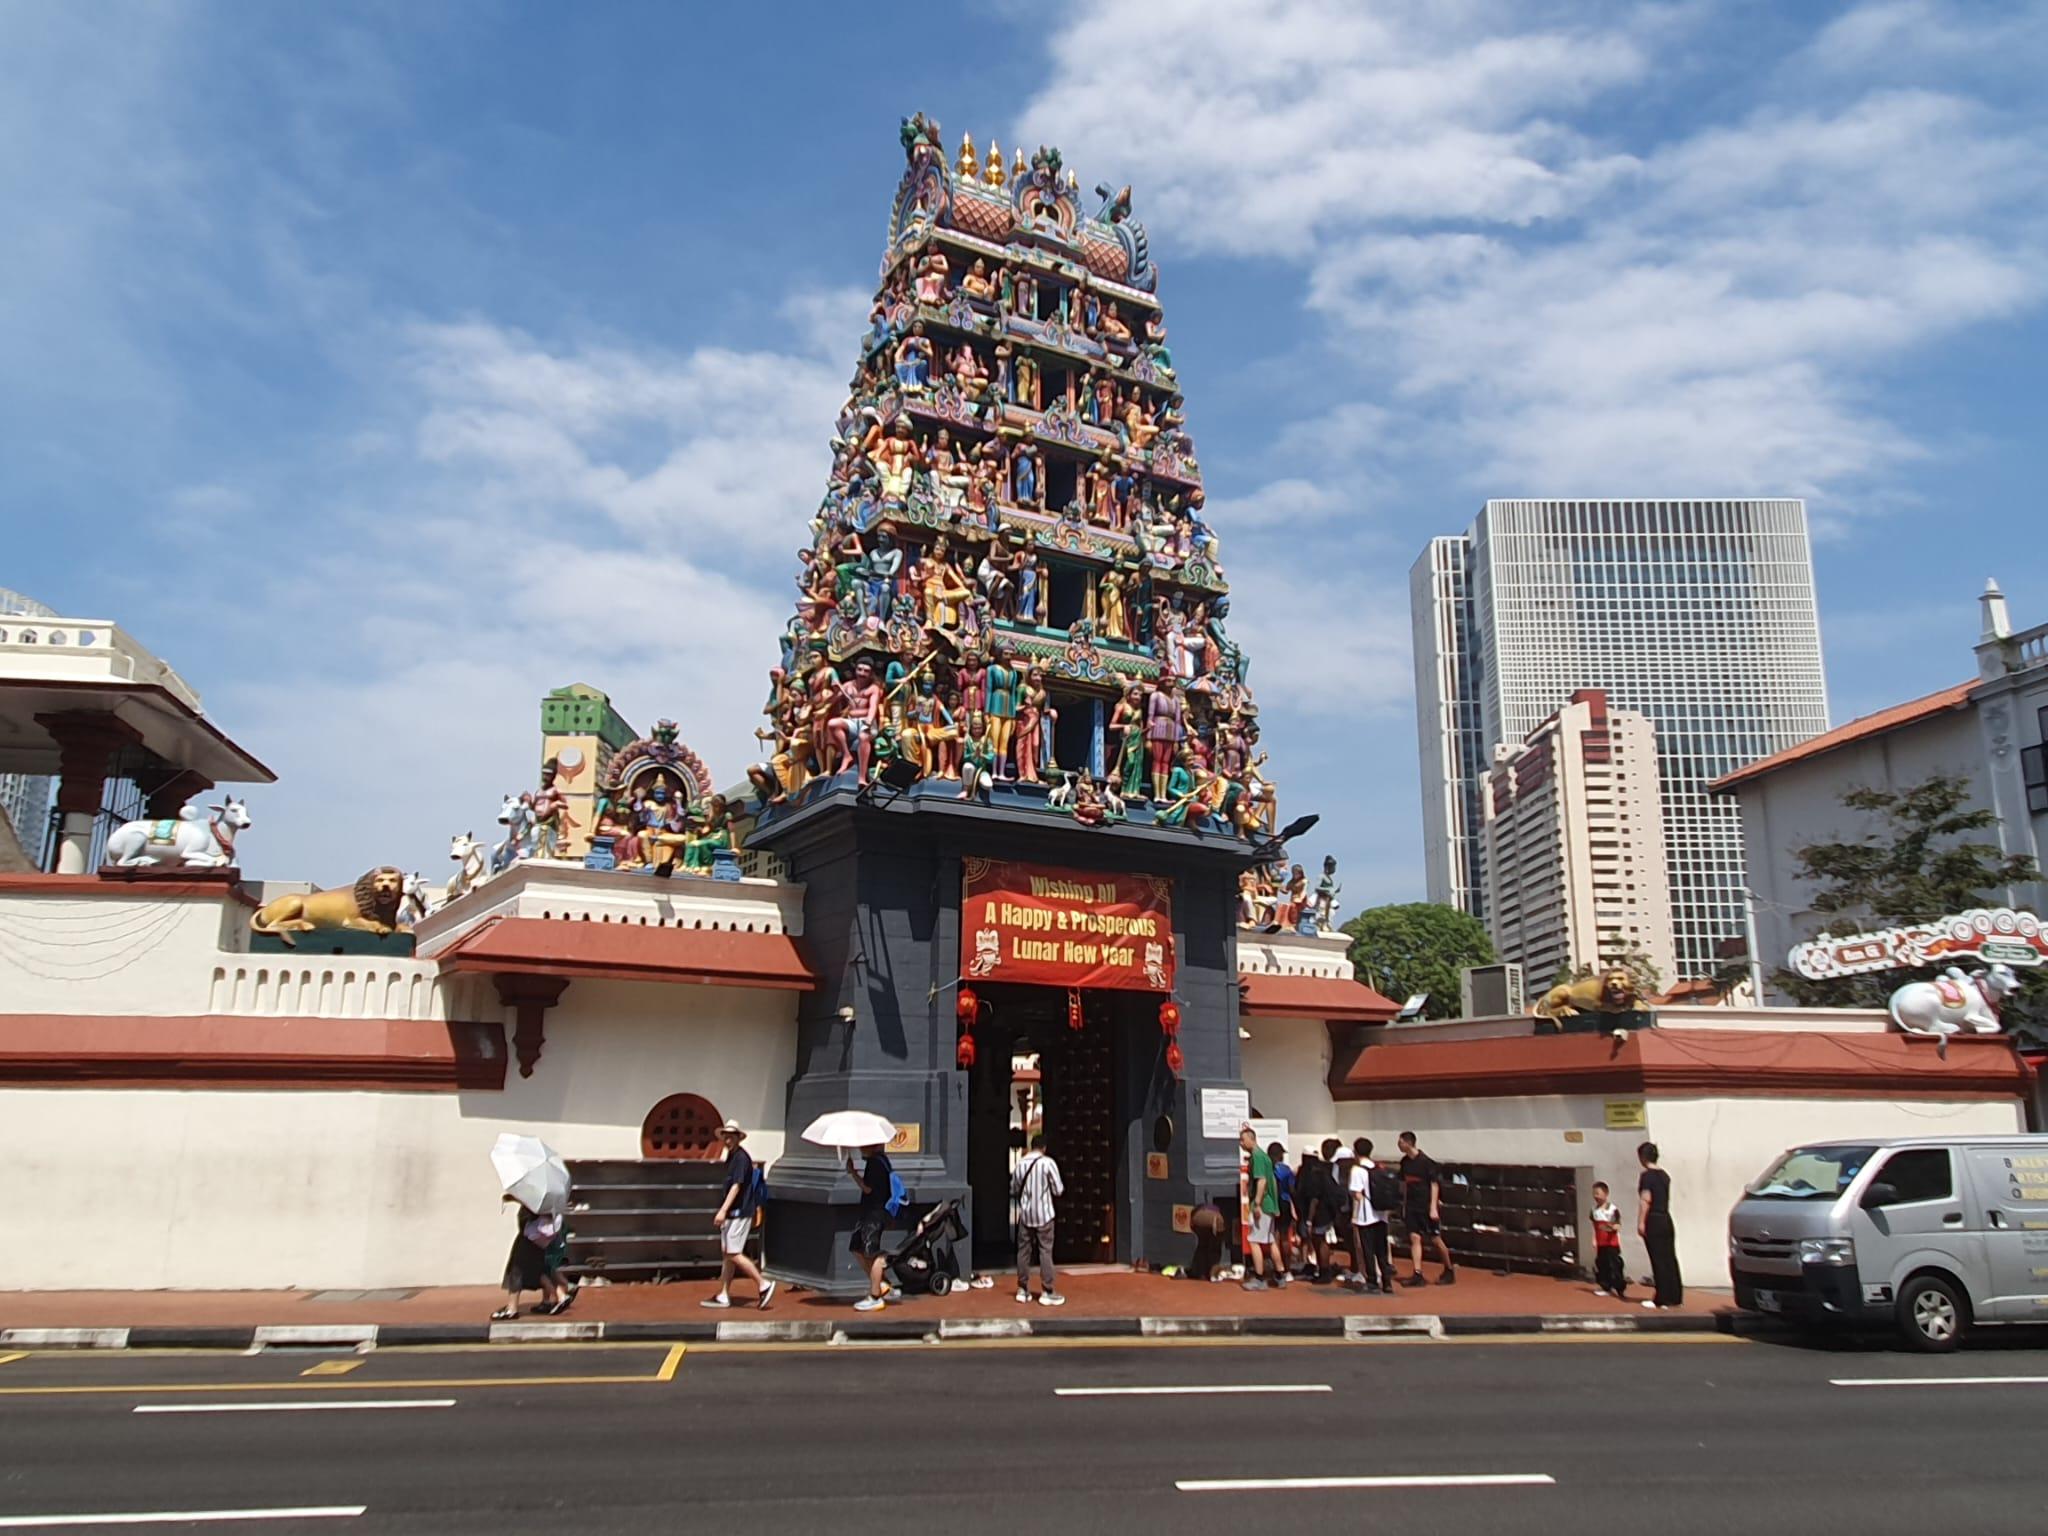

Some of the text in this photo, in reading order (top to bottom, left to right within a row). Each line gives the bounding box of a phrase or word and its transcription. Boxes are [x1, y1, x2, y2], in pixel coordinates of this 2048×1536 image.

[1030, 875, 1117, 904] Wishing All
[985, 901, 1157, 938] A Happy & Prosperous
[1012, 936, 1135, 967] Lunar New Year
